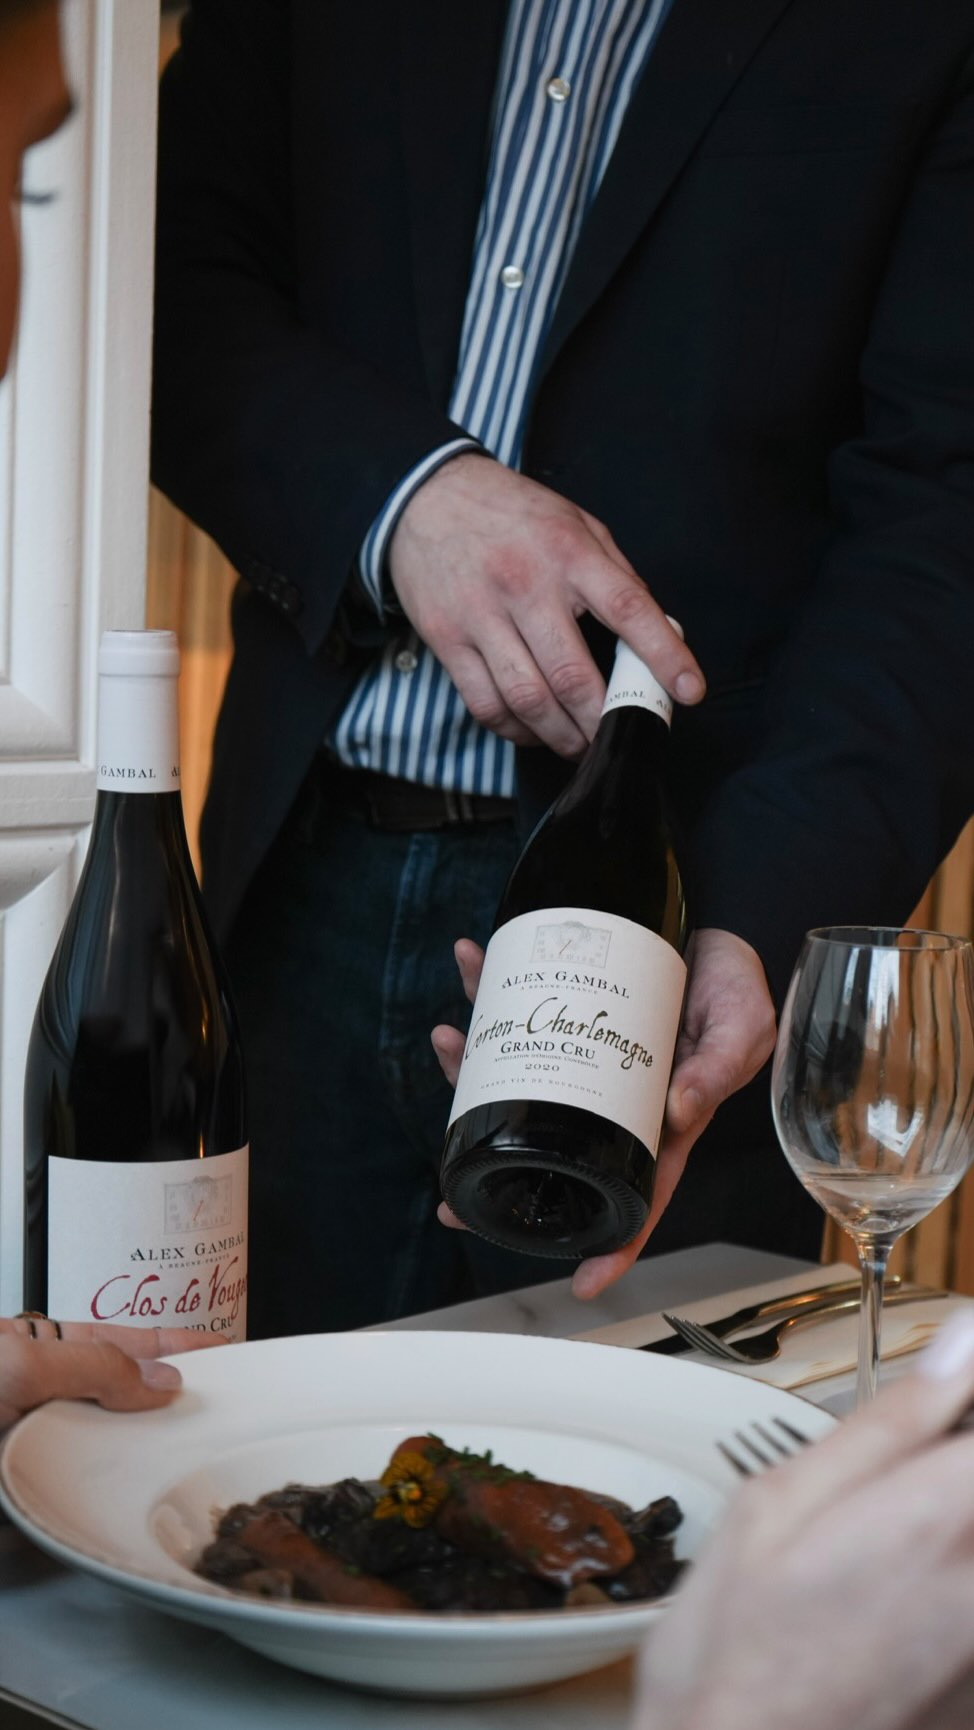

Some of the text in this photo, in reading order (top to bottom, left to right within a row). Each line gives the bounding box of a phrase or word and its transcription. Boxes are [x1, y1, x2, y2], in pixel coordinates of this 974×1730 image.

[100, 765, 157, 778] GAMBAL
[501, 970, 630, 999] ALEX GAMBAL
[464, 996, 653, 1070] Corton-Charlemagne
[500, 1041, 596, 1060] GRAND CRU
[525, 1063, 560, 1072] 2020
[130, 1248, 185, 1262] ALEX
[90, 1273, 168, 1320] Clos
[174, 1278, 201, 1314] de
[210, 1316, 235, 1333] CRU
